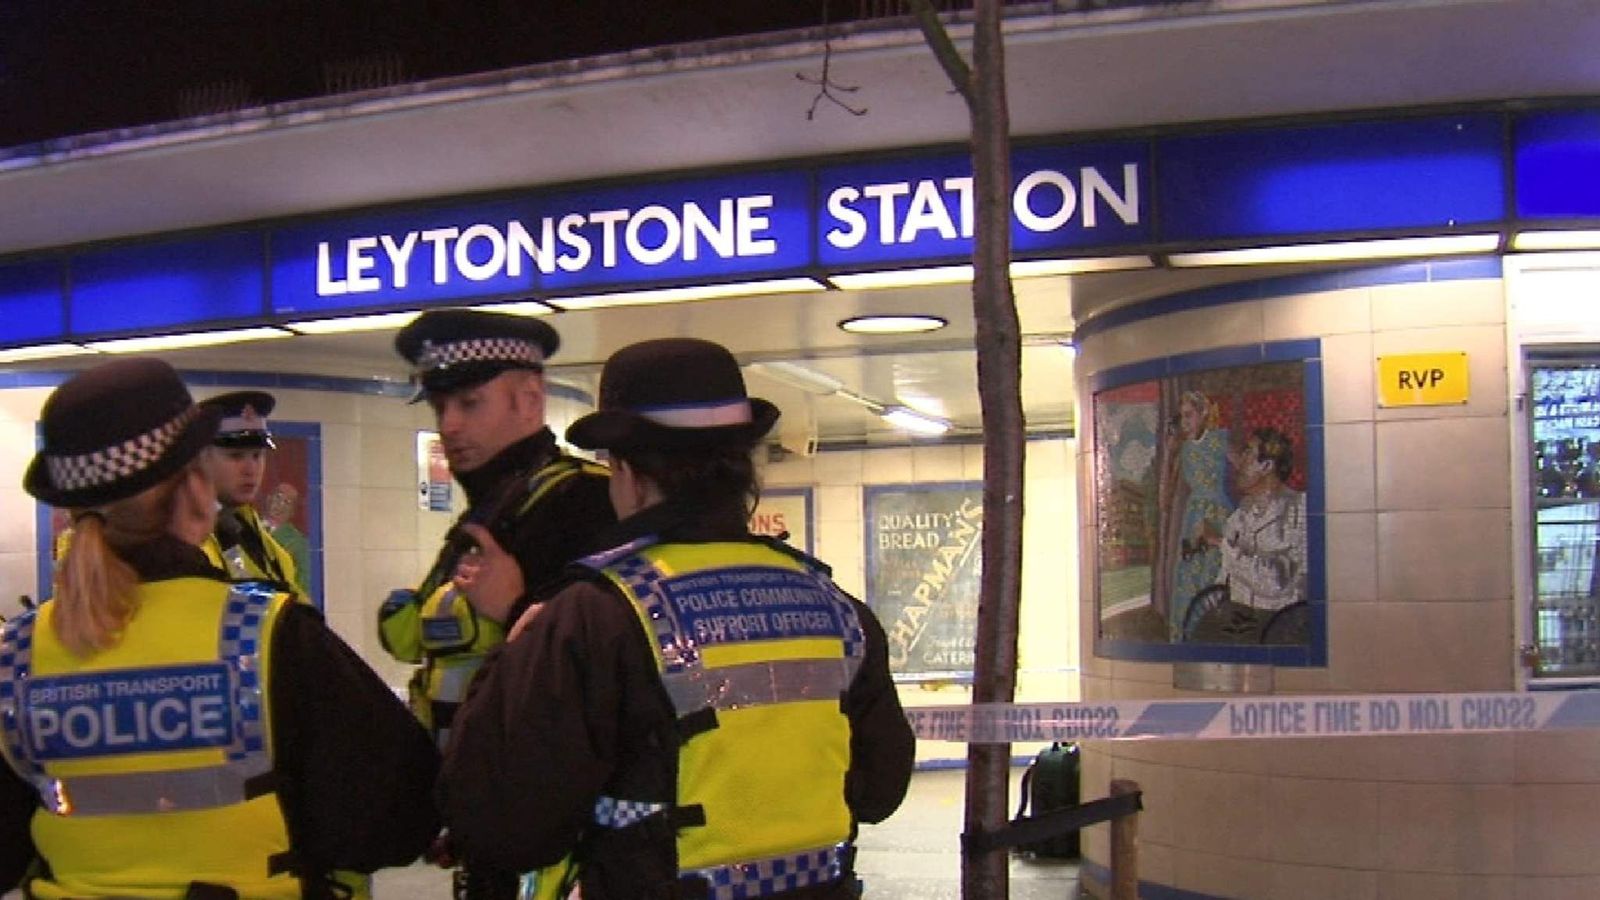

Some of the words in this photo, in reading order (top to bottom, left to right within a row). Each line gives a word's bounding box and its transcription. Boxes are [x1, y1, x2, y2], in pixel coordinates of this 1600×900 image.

[315, 194, 778, 297] LEYTONSTONE
[825, 162, 1139, 249] STATON
[1398, 368, 1445, 390] RVP
[879, 511, 953, 531] QUALITY
[879, 530, 941, 550] BREAD
[675, 589, 740, 614] POLICE
[693, 613, 769, 637] SUPPORT
[771, 610, 834, 632] OFFICER
[29, 683, 99, 703] BRITISH
[103, 673, 220, 697] TRANSPORT
[32, 695, 225, 752] POLICE
